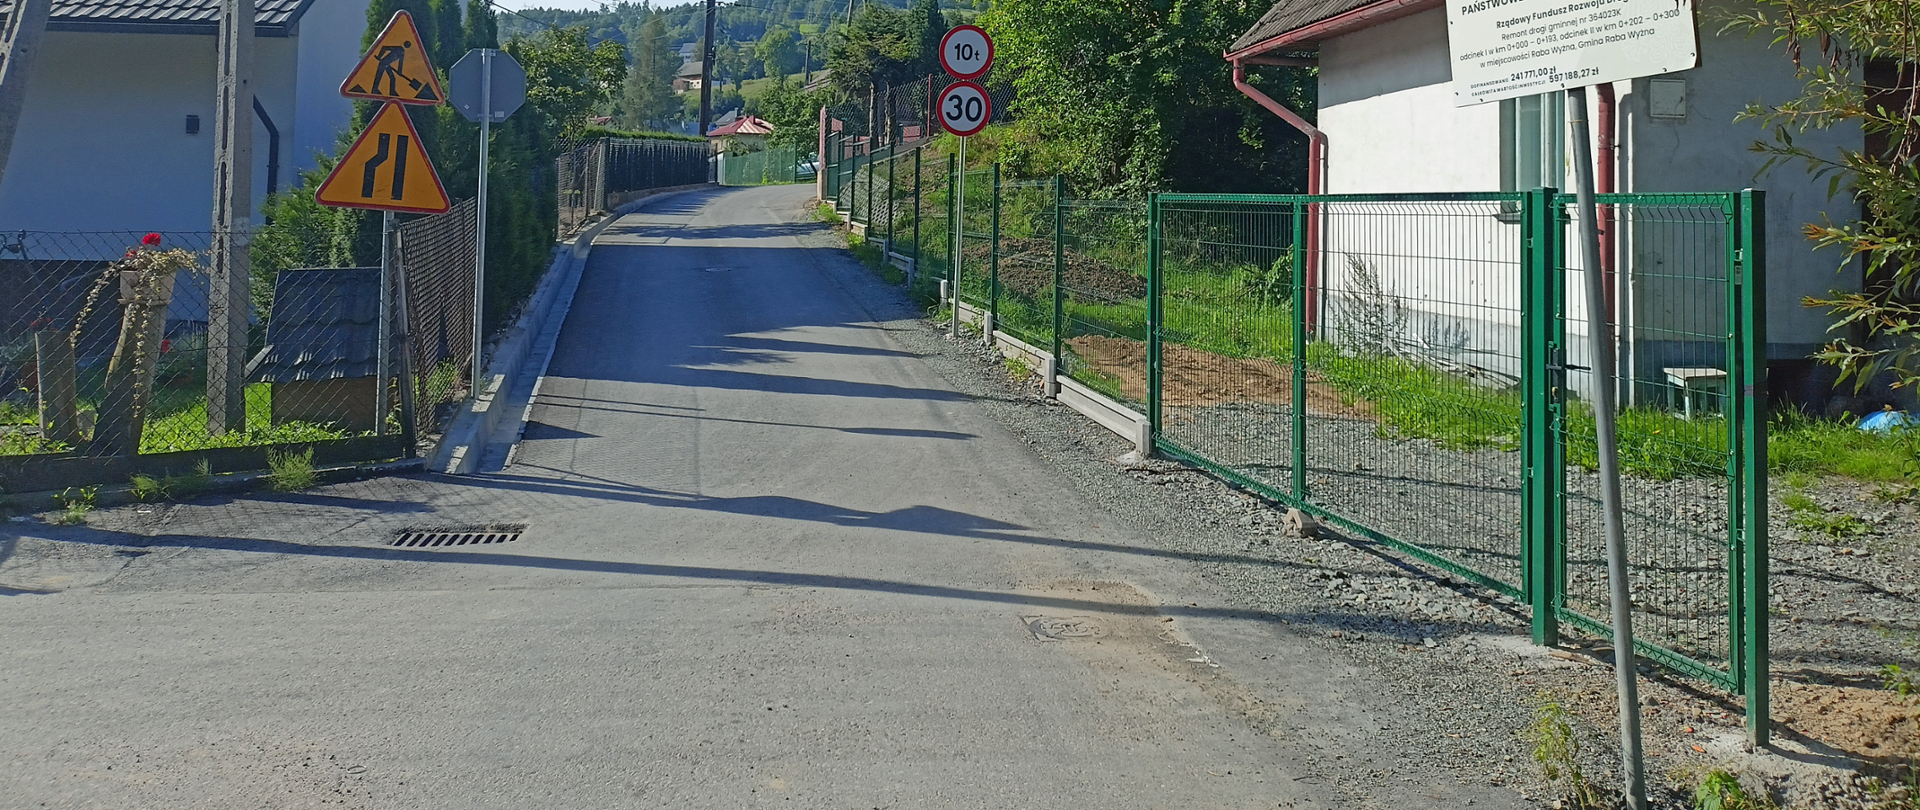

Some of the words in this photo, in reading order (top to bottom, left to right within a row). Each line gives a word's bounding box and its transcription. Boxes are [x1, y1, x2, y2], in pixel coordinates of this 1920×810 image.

[1496, 15, 1531, 29] Rządowy
[1532, 7, 1567, 20] Fundusz
[1568, 0, 1605, 12] Rozwoju
[1501, 30, 1528, 41] Remont
[1528, 23, 1547, 35] drogi
[1548, 17, 1578, 32] gminnej
[1579, 16, 1587, 24] nr
[1588, 8, 1622, 22] 364023K
[1459, 51, 1484, 62] odcinek
[1495, 44, 1507, 53] km
[1506, 40, 1529, 51] 0+000
[1559, 29, 1589, 41] odcinek
[1590, 27, 1595, 35] II
[1603, 22, 1617, 32] km
[1618, 15, 1644, 28] 0+202
[1652, 9, 1680, 21] 0+300
[1486, 53, 1531, 67] miejscowości
[1531, 48, 1550, 58] Raba
[1551, 43, 1577, 55] Wyżna,
[1578, 38, 1604, 49] Gmina
[1604, 32, 1626, 43] Raba
[1627, 28, 1655, 40] Wyżna
[1549, 66, 1557, 75] zł
[1591, 67, 1600, 76] zł
[945, 94, 983, 122] 30
